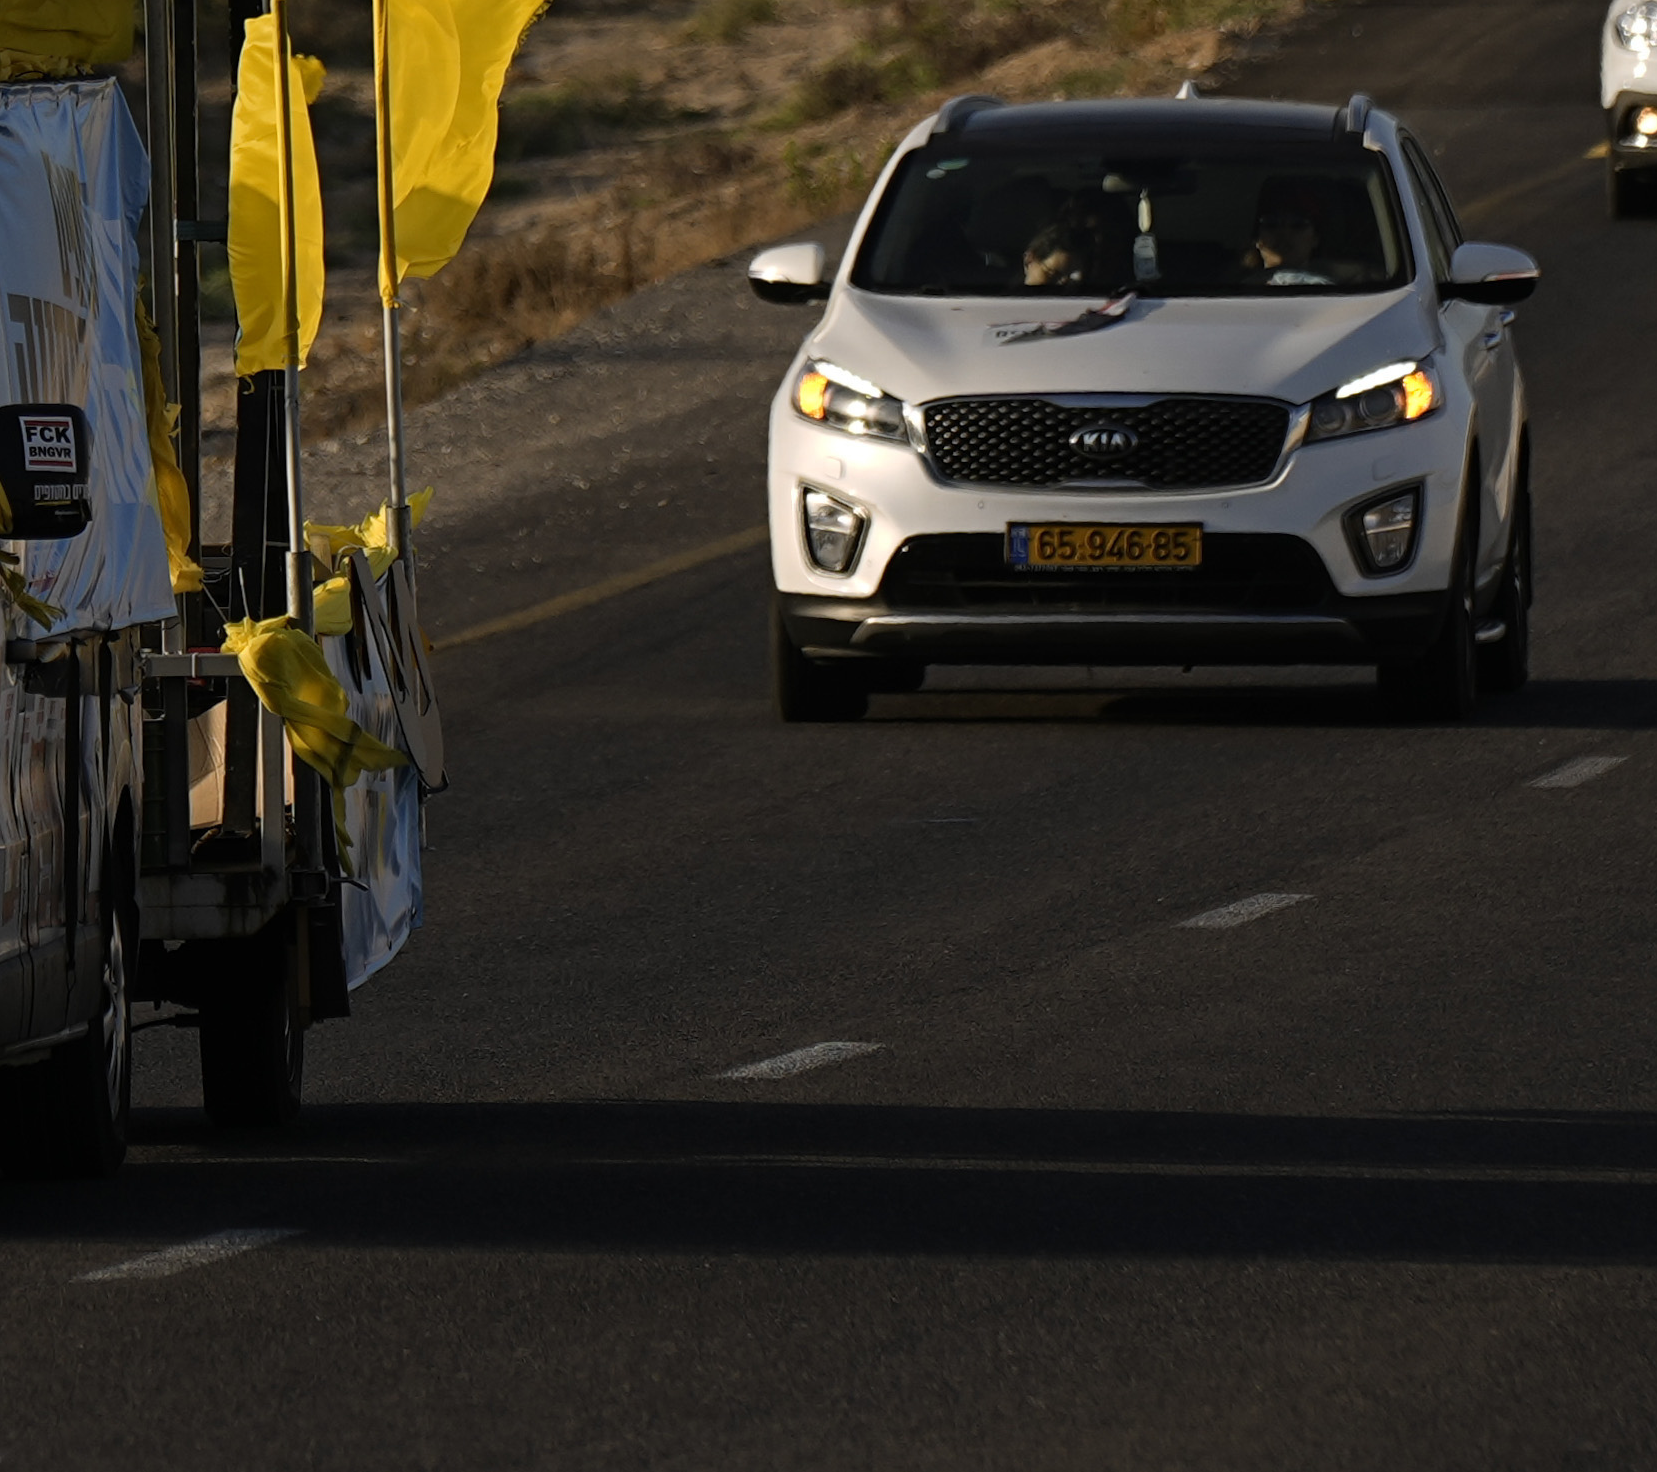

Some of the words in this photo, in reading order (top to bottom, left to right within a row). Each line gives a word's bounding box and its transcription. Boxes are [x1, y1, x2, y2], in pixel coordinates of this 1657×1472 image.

[25, 426, 71, 444] FCK
[1082, 431, 1129, 453] KIA
[29, 446, 71, 458] BNGVR
